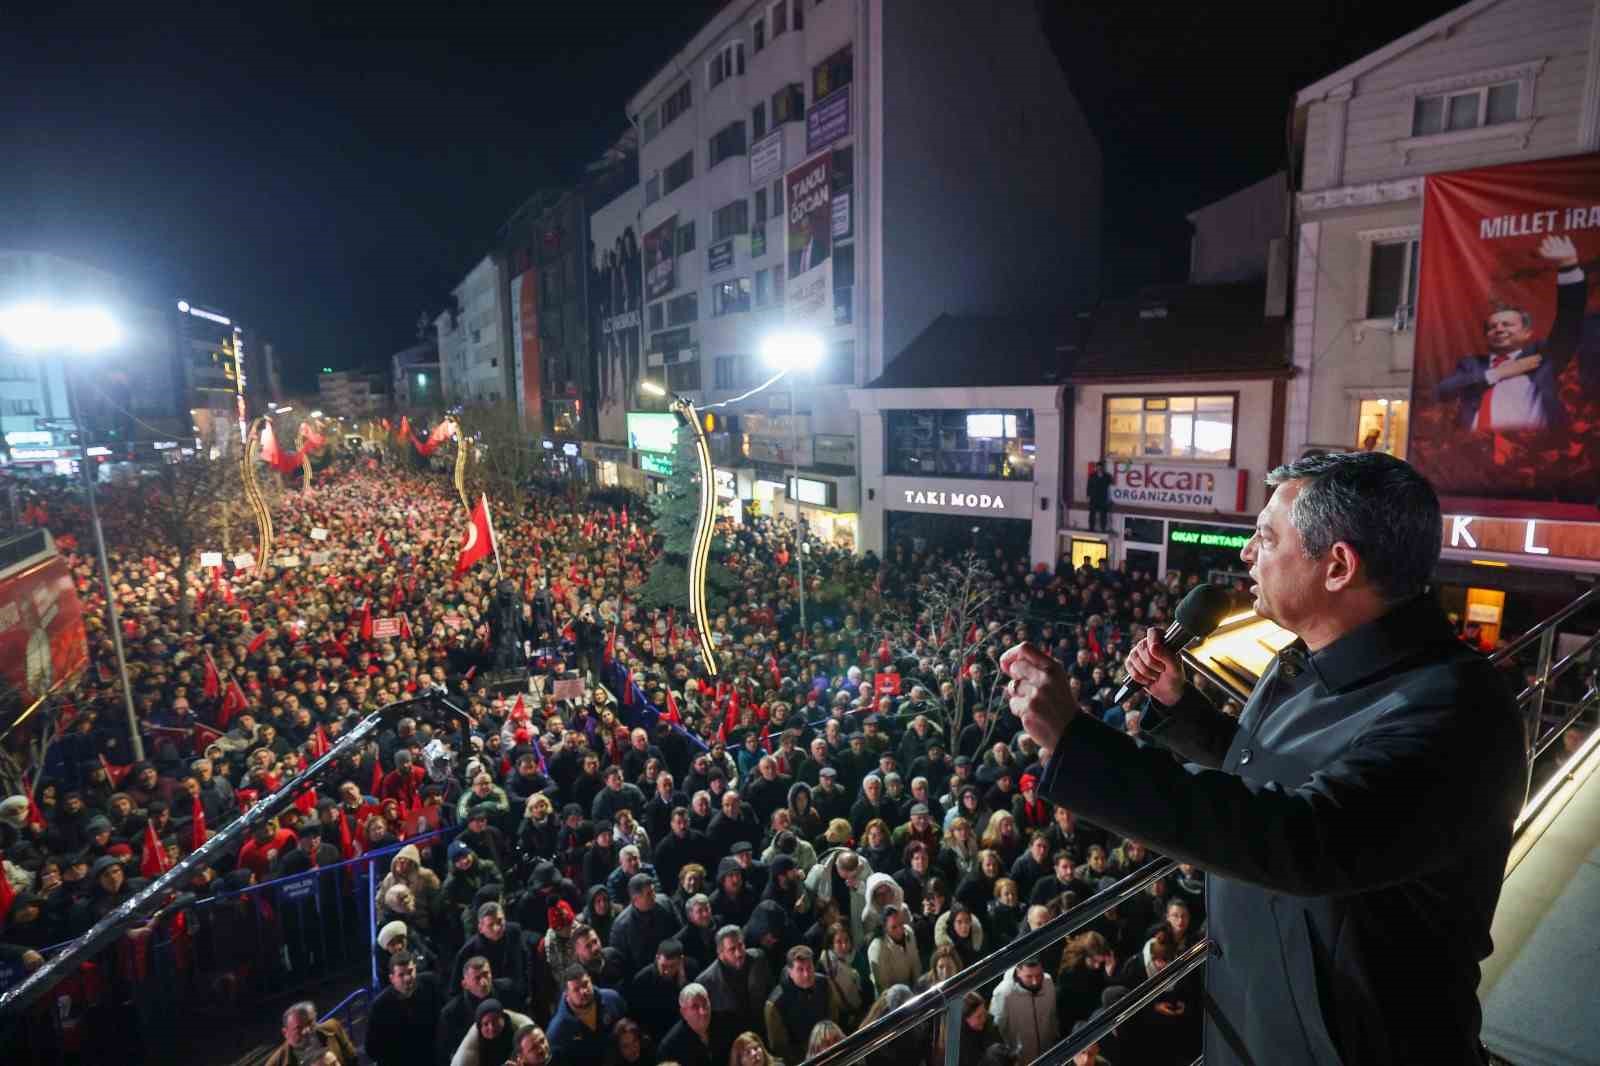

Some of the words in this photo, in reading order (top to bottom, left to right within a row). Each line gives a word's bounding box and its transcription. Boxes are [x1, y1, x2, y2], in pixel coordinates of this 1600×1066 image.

[904, 490, 946, 505] TAKI
[951, 492, 1005, 509] MODA
[1451, 515, 1477, 548] K
[1524, 519, 1549, 554] L
